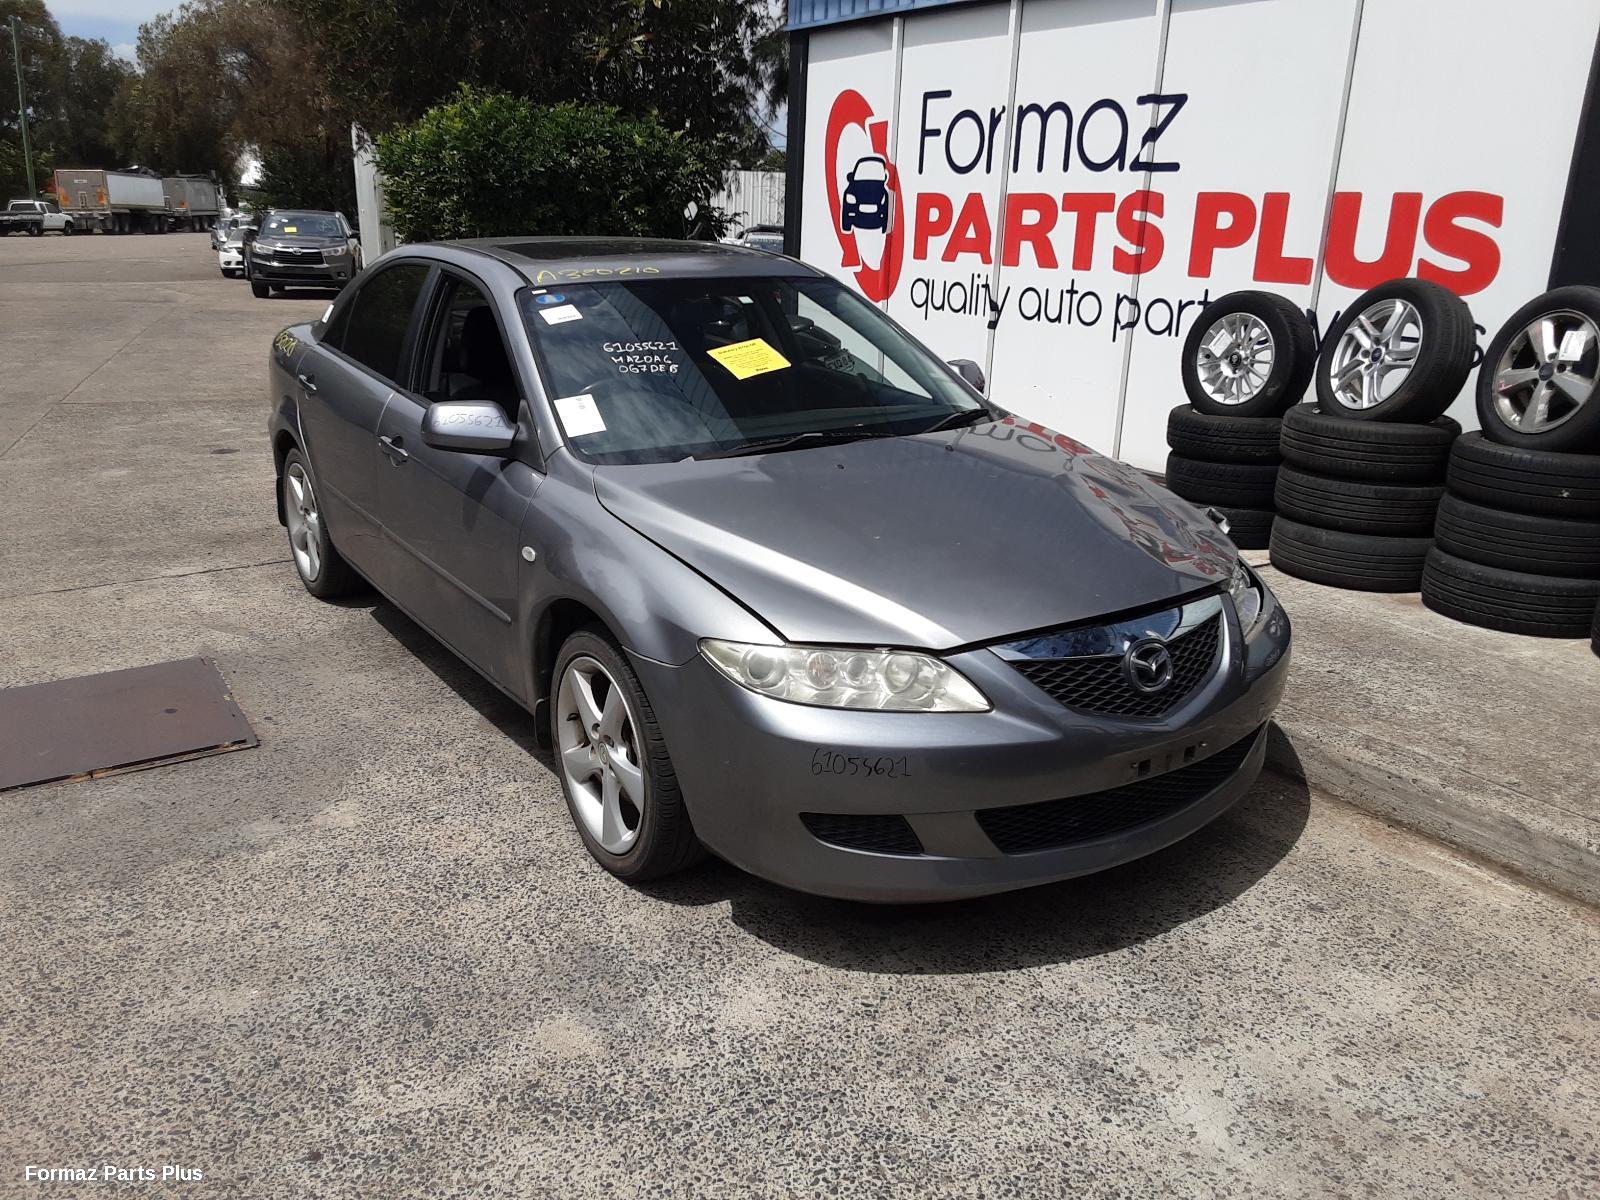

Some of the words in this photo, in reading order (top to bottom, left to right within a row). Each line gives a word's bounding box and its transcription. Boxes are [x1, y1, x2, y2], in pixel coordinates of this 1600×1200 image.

[918, 89, 1189, 175] Formaz
[913, 189, 1165, 275] PARTS
[1188, 190, 1504, 297] PLUS
[910, 273, 1011, 331] quality
[1018, 278, 1103, 327] auto
[1112, 288, 1214, 342] part
[811, 747, 912, 778] 61055621
